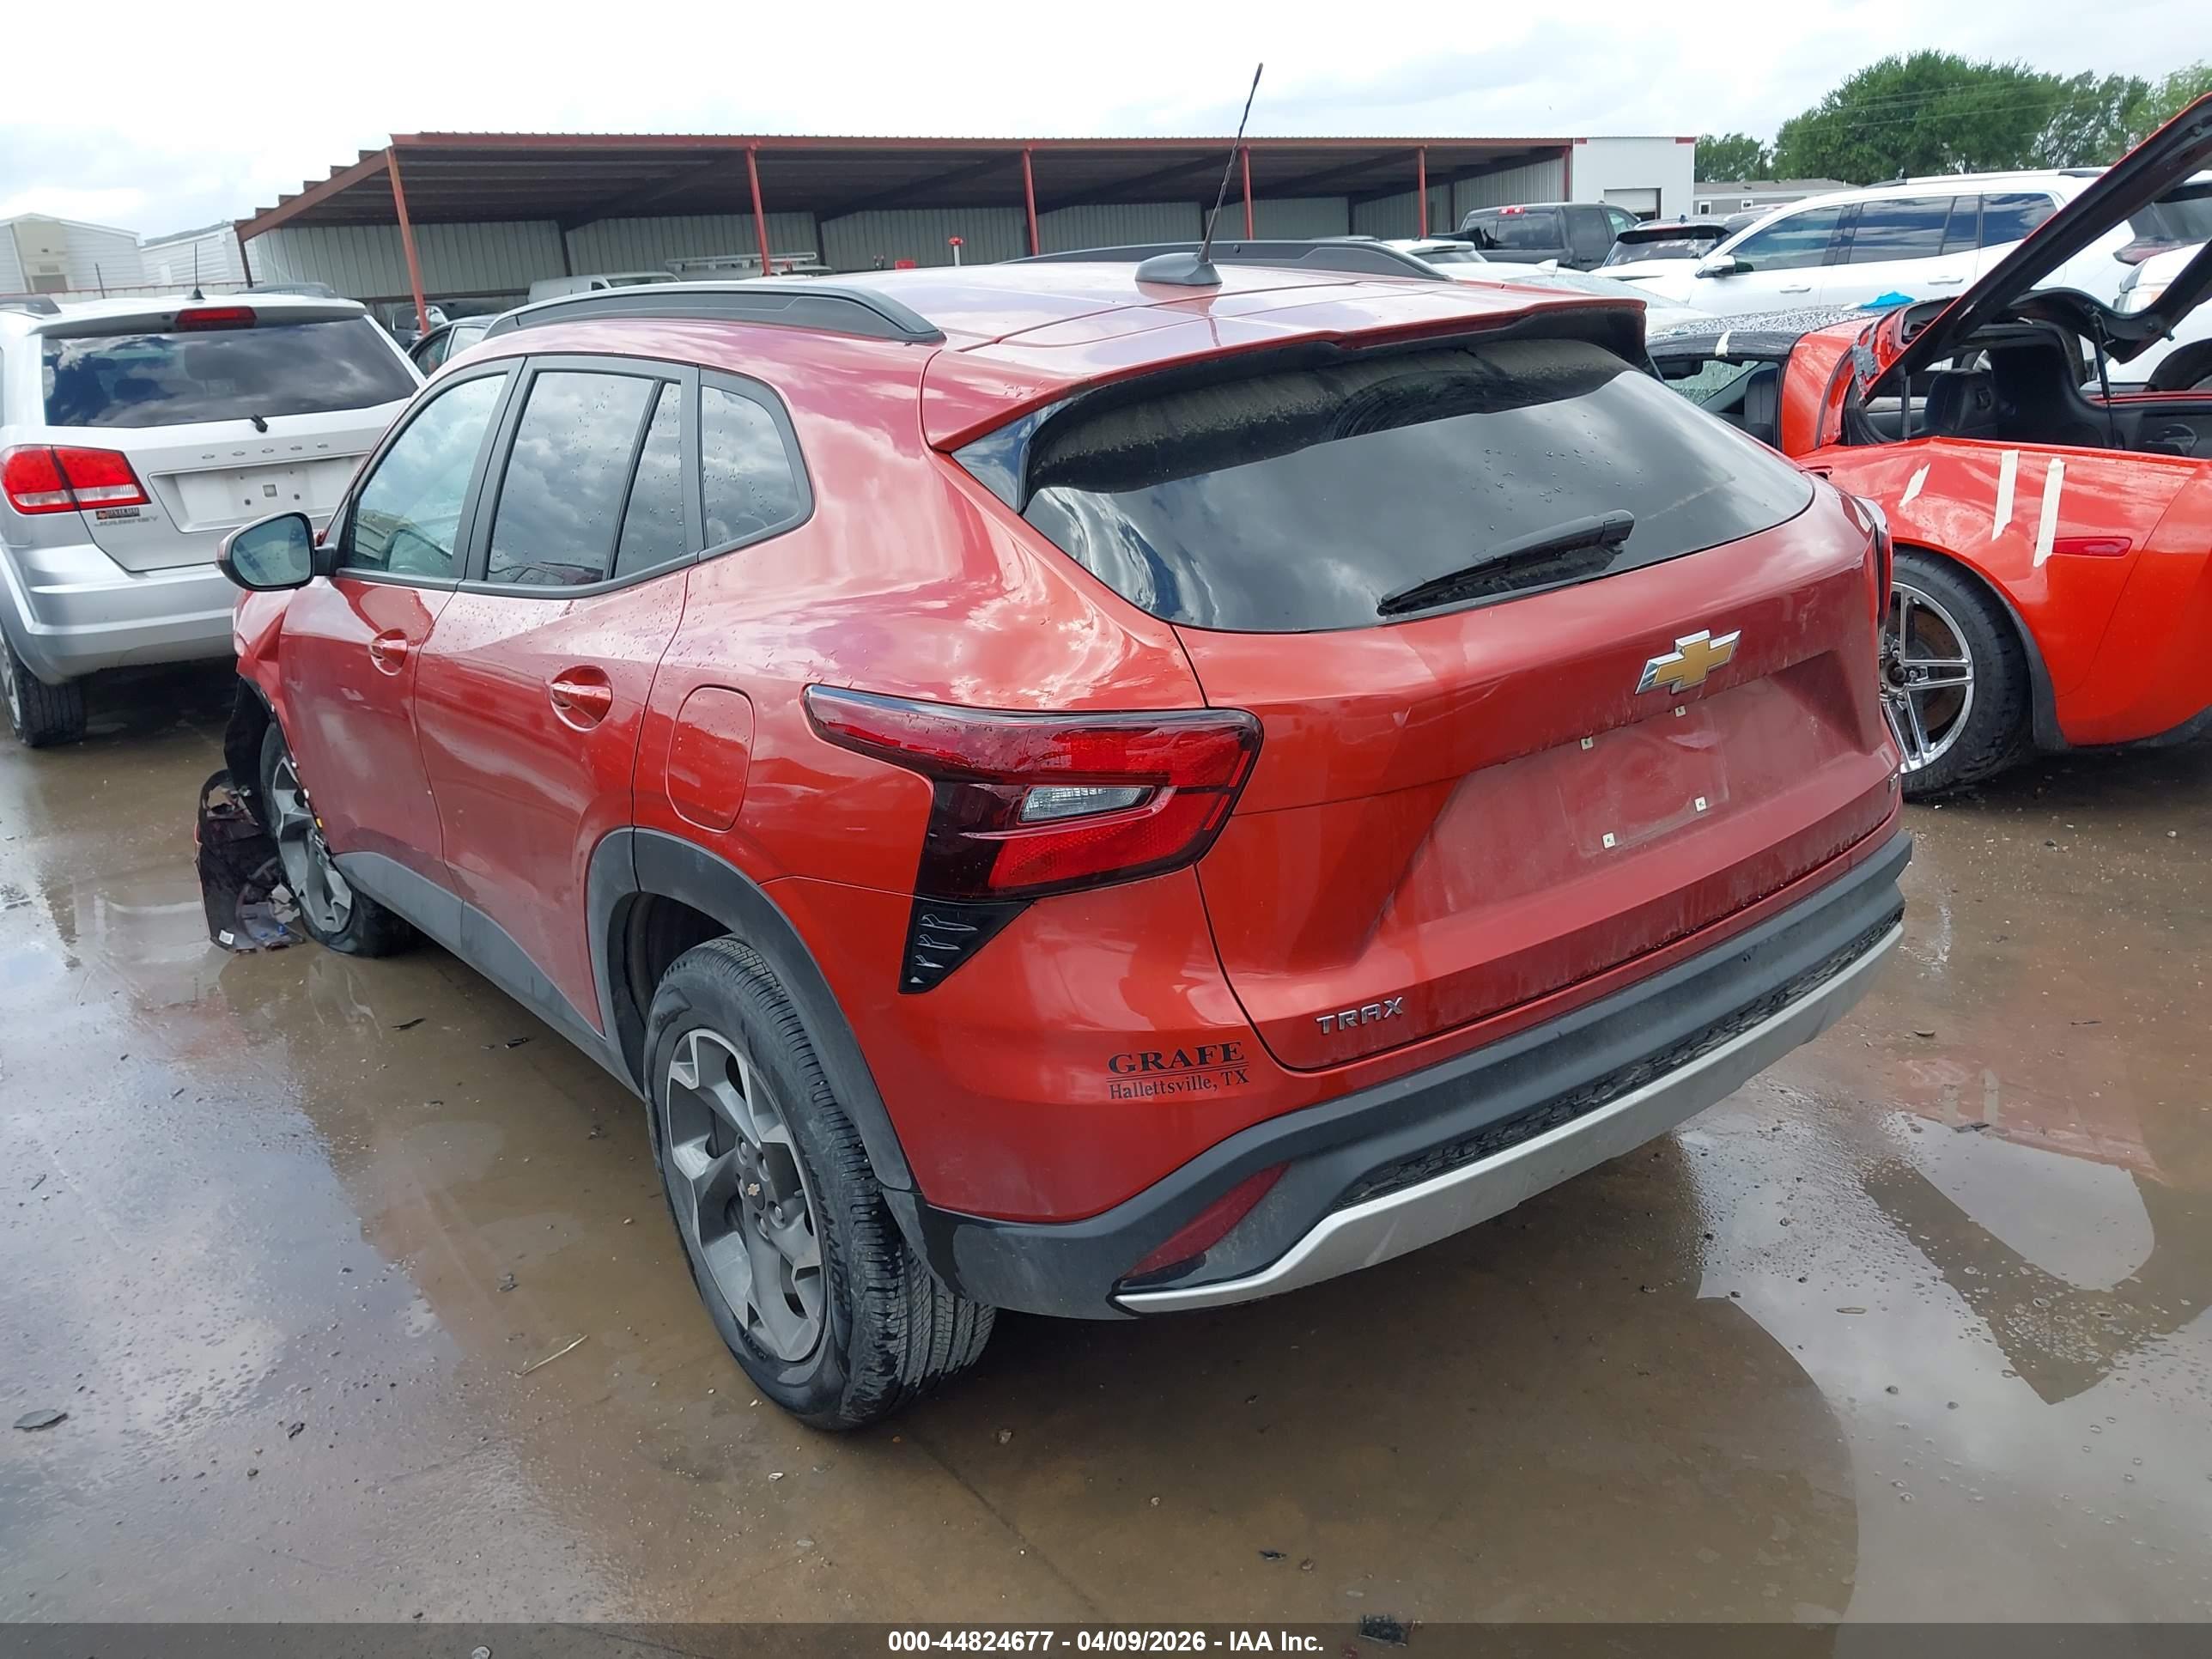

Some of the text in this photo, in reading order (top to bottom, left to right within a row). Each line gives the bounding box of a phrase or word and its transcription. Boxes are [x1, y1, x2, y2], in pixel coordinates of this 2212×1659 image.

[1316, 996, 1404, 1036] TRAX
[1107, 1041, 1245, 1075] GRAFE
[1109, 1068, 1251, 1100] Hallettsville, TX
